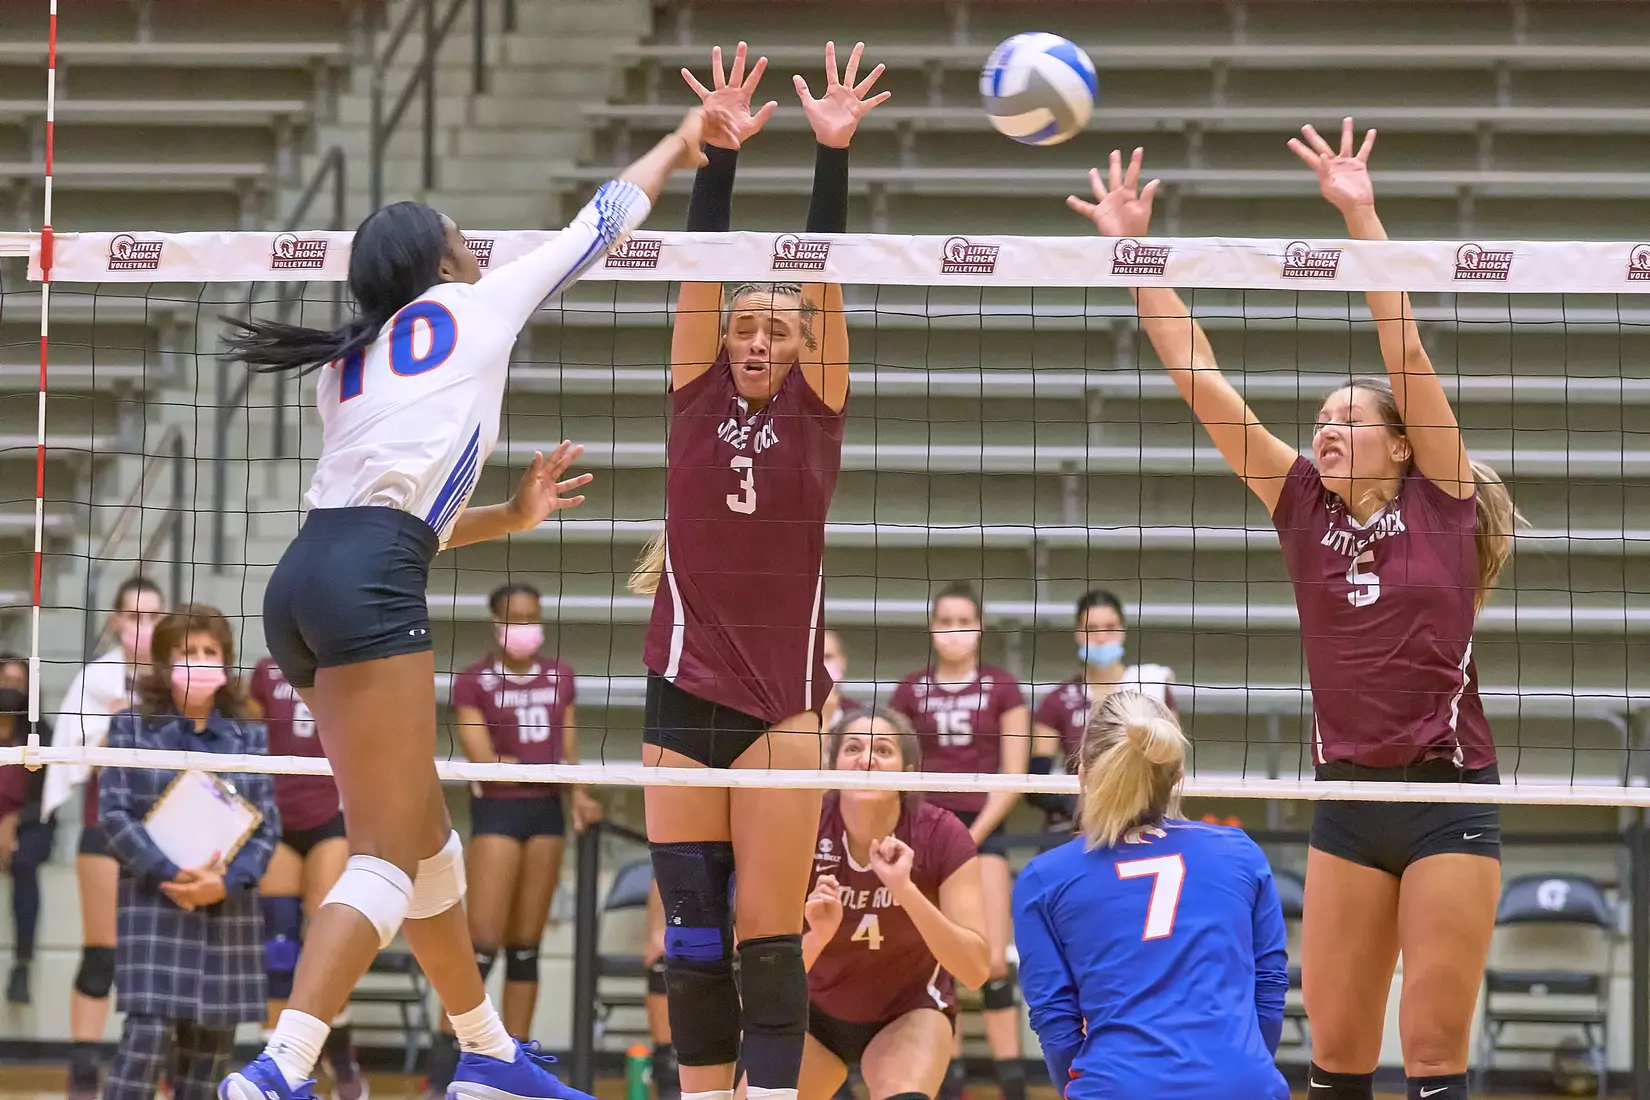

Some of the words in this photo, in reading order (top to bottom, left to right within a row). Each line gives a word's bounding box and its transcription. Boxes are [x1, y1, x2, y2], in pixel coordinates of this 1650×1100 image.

[132, 243, 161, 251] LITTLE
[296, 241, 327, 250] LITTLE
[630, 241, 660, 250] LITTLE
[798, 243, 829, 251] LITTLE
[294, 250, 325, 258] ROCK
[967, 246, 1000, 255] LITTLE
[1137, 248, 1168, 256] LITTLE
[129, 251, 159, 259] ROCK
[966, 254, 996, 262] ROCK
[1308, 251, 1340, 259] LITTLE
[1480, 252, 1513, 261] LITTLE
[274, 260, 322, 268] VOLLEYBALL
[607, 259, 656, 268] VOLLEYBALL
[1136, 256, 1166, 264] ROCK
[1306, 259, 1337, 267] ROCK
[110, 261, 156, 269] VOLLEYBALL
[944, 265, 992, 273] VOLLEYBALL
[1479, 261, 1510, 270] ROCK
[1113, 266, 1163, 274] VOLLEYBALL
[726, 455, 757, 515] 3
[1345, 550, 1380, 608] 5
[515, 706, 549, 743] 10
[933, 711, 972, 746] 15
[1114, 853, 1187, 942] 7
[851, 913, 885, 950] 4
